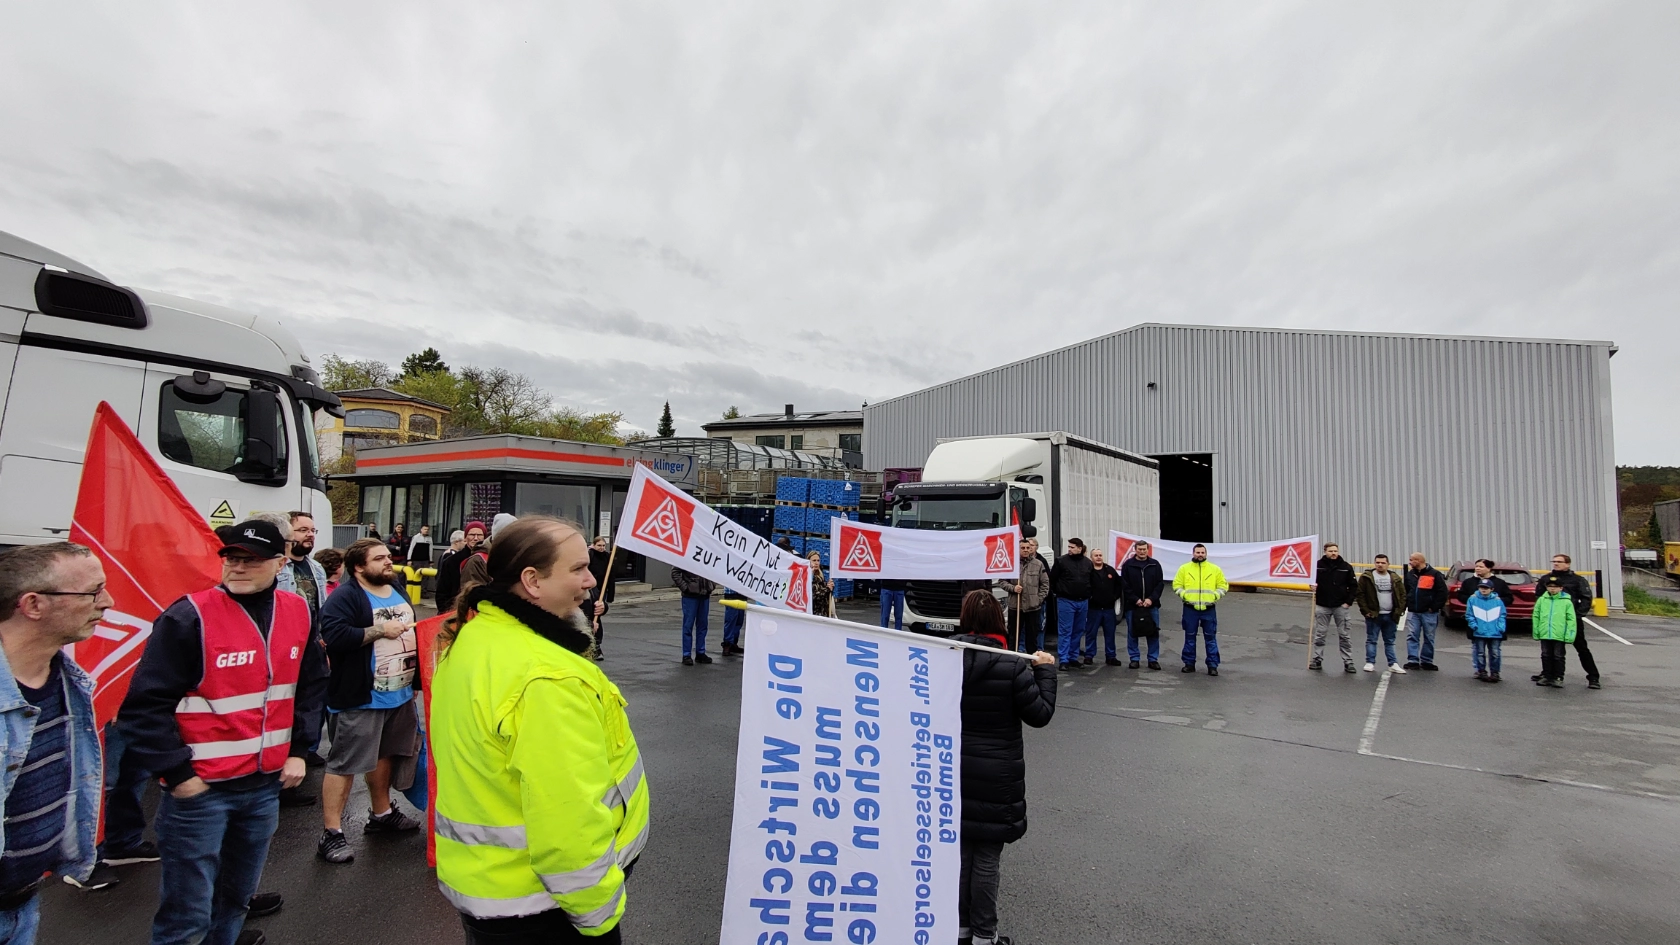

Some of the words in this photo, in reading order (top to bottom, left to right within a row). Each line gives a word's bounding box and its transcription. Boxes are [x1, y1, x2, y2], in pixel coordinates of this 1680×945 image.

[626, 456, 684, 474] elingklinger
[711, 514, 747, 553] Kein
[752, 538, 781, 570] Mut
[692, 545, 722, 568] zur
[726, 553, 787, 600] Wahrheit?
[216, 650, 256, 668] GEBT
